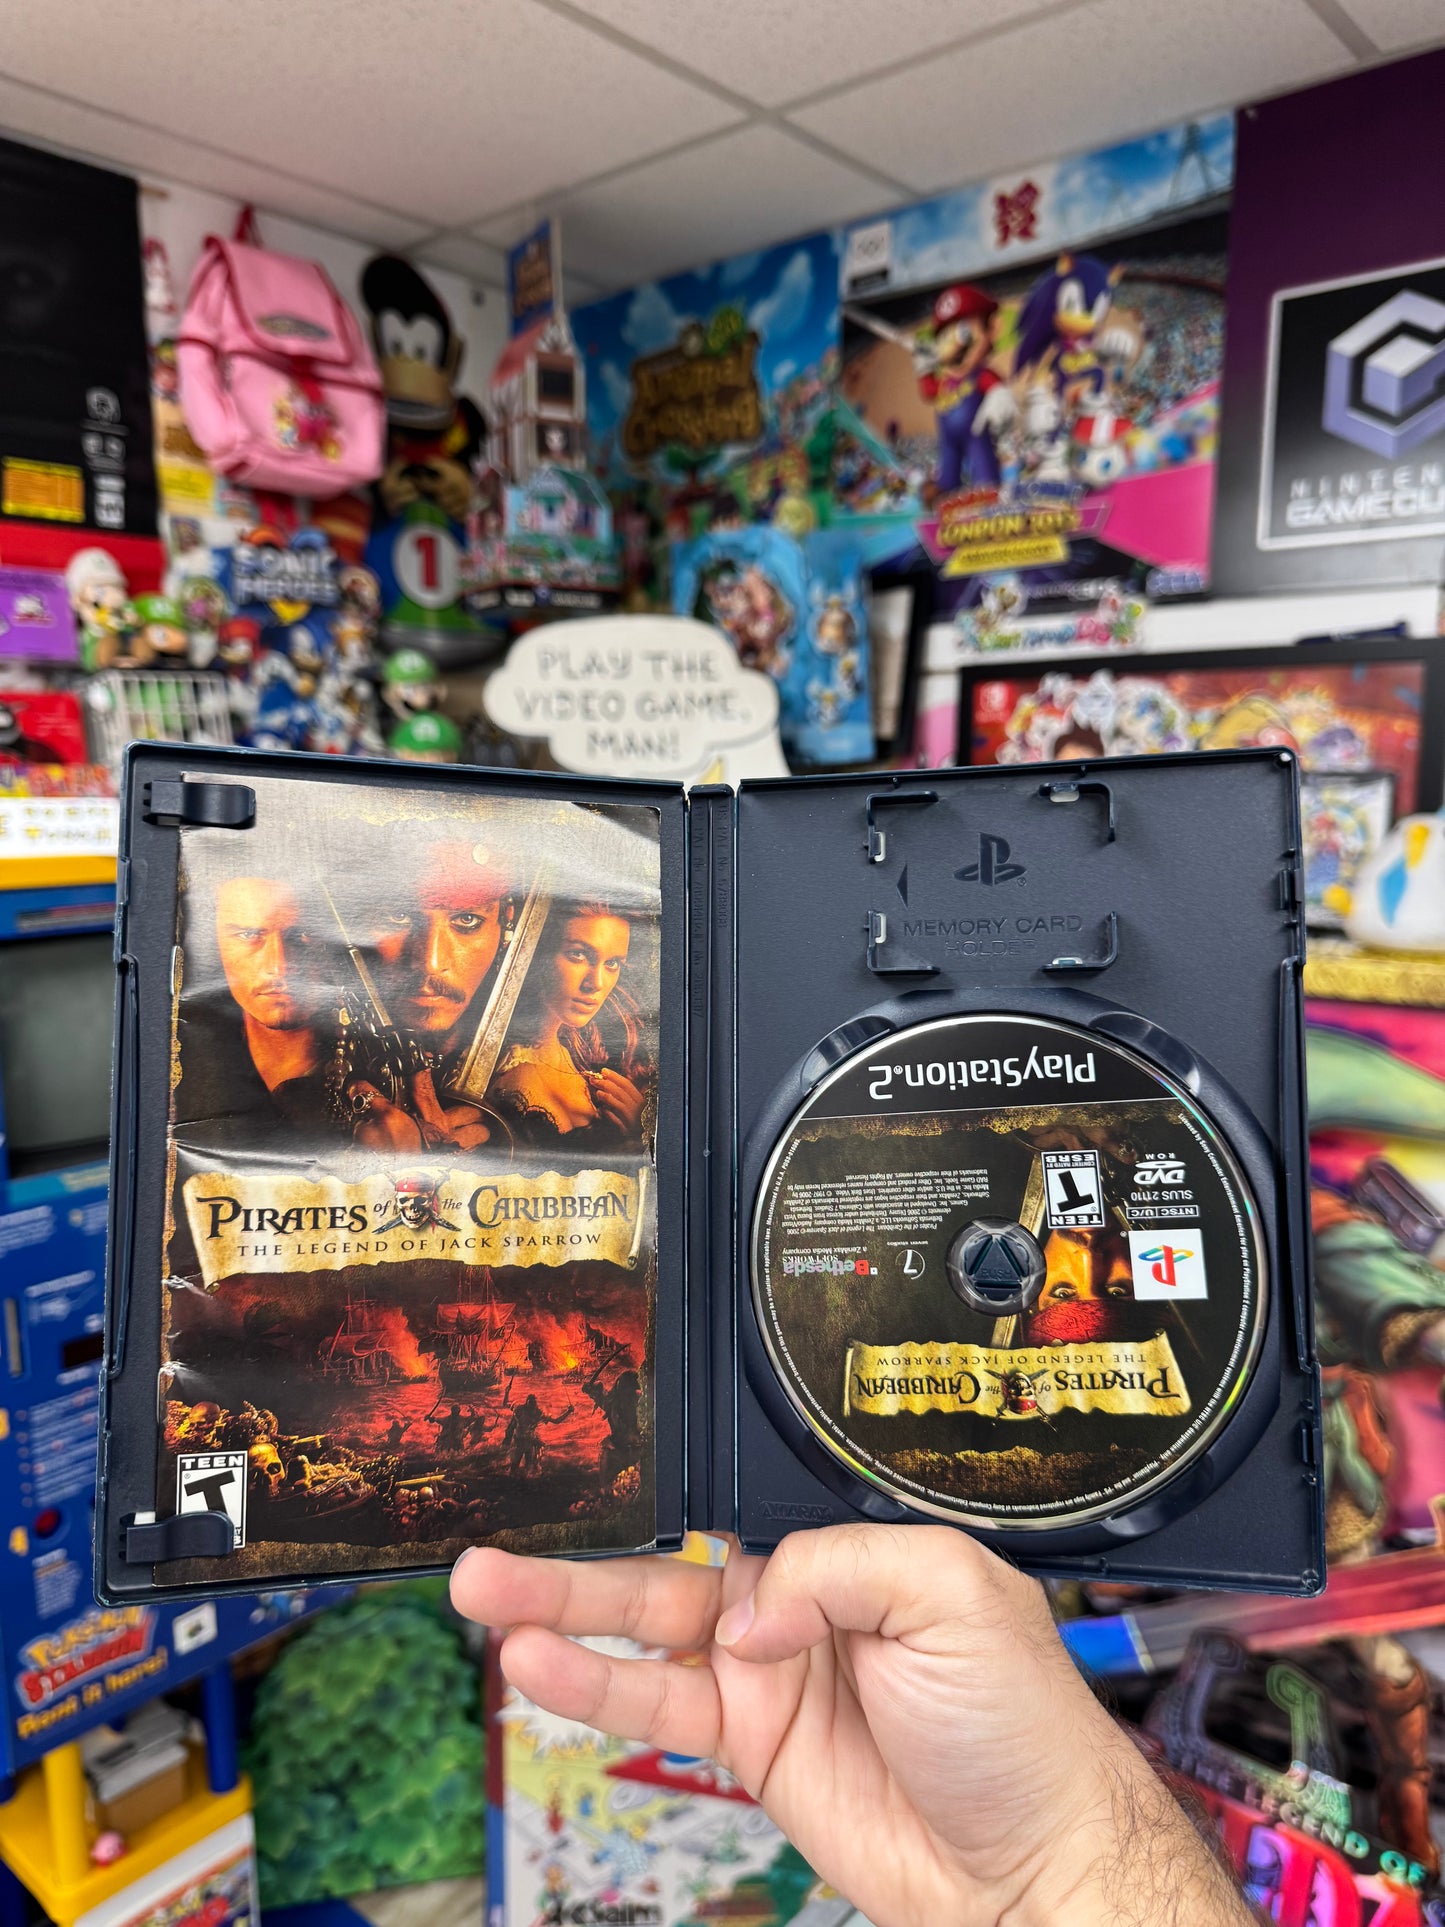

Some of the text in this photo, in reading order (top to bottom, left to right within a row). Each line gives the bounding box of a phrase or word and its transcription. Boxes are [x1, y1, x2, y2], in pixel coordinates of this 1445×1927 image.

[538, 646, 719, 681] PLAY THE
[514, 687, 626, 721] VIDEO
[587, 729, 680, 759] MAN!
[904, 915, 1082, 937] MEMORY CARD
[1045, 1154, 1095, 1162] ESRB
[1133, 1168, 1185, 1185] DVD
[1056, 1170, 1094, 1213] T
[1130, 1189, 1193, 1201] SLUS 21110
[196, 1184, 632, 1240] PIRATES of the CARIBBEAN
[1051, 1214, 1102, 1225] TEEN
[1131, 1207, 1194, 1216] NTSC U/C
[238, 1233, 603, 1258] THE LEGEND OF JACK SPARROW
[782, 1247, 810, 1255] company
[812, 1247, 832, 1255] Media
[833, 1246, 861, 1254] ZeniMax
[782, 1255, 839, 1263] SOFTWORKS
[903, 1249, 918, 1274] 7
[783, 1259, 869, 1277] Bethesda
[876, 1354, 1146, 1366] THE LEGEND OF JACK SPARROW
[853, 1366, 1181, 1404] PIRATES of the CARIBBEAN
[182, 1455, 244, 1469] TEEN
[184, 1469, 236, 1516] T
